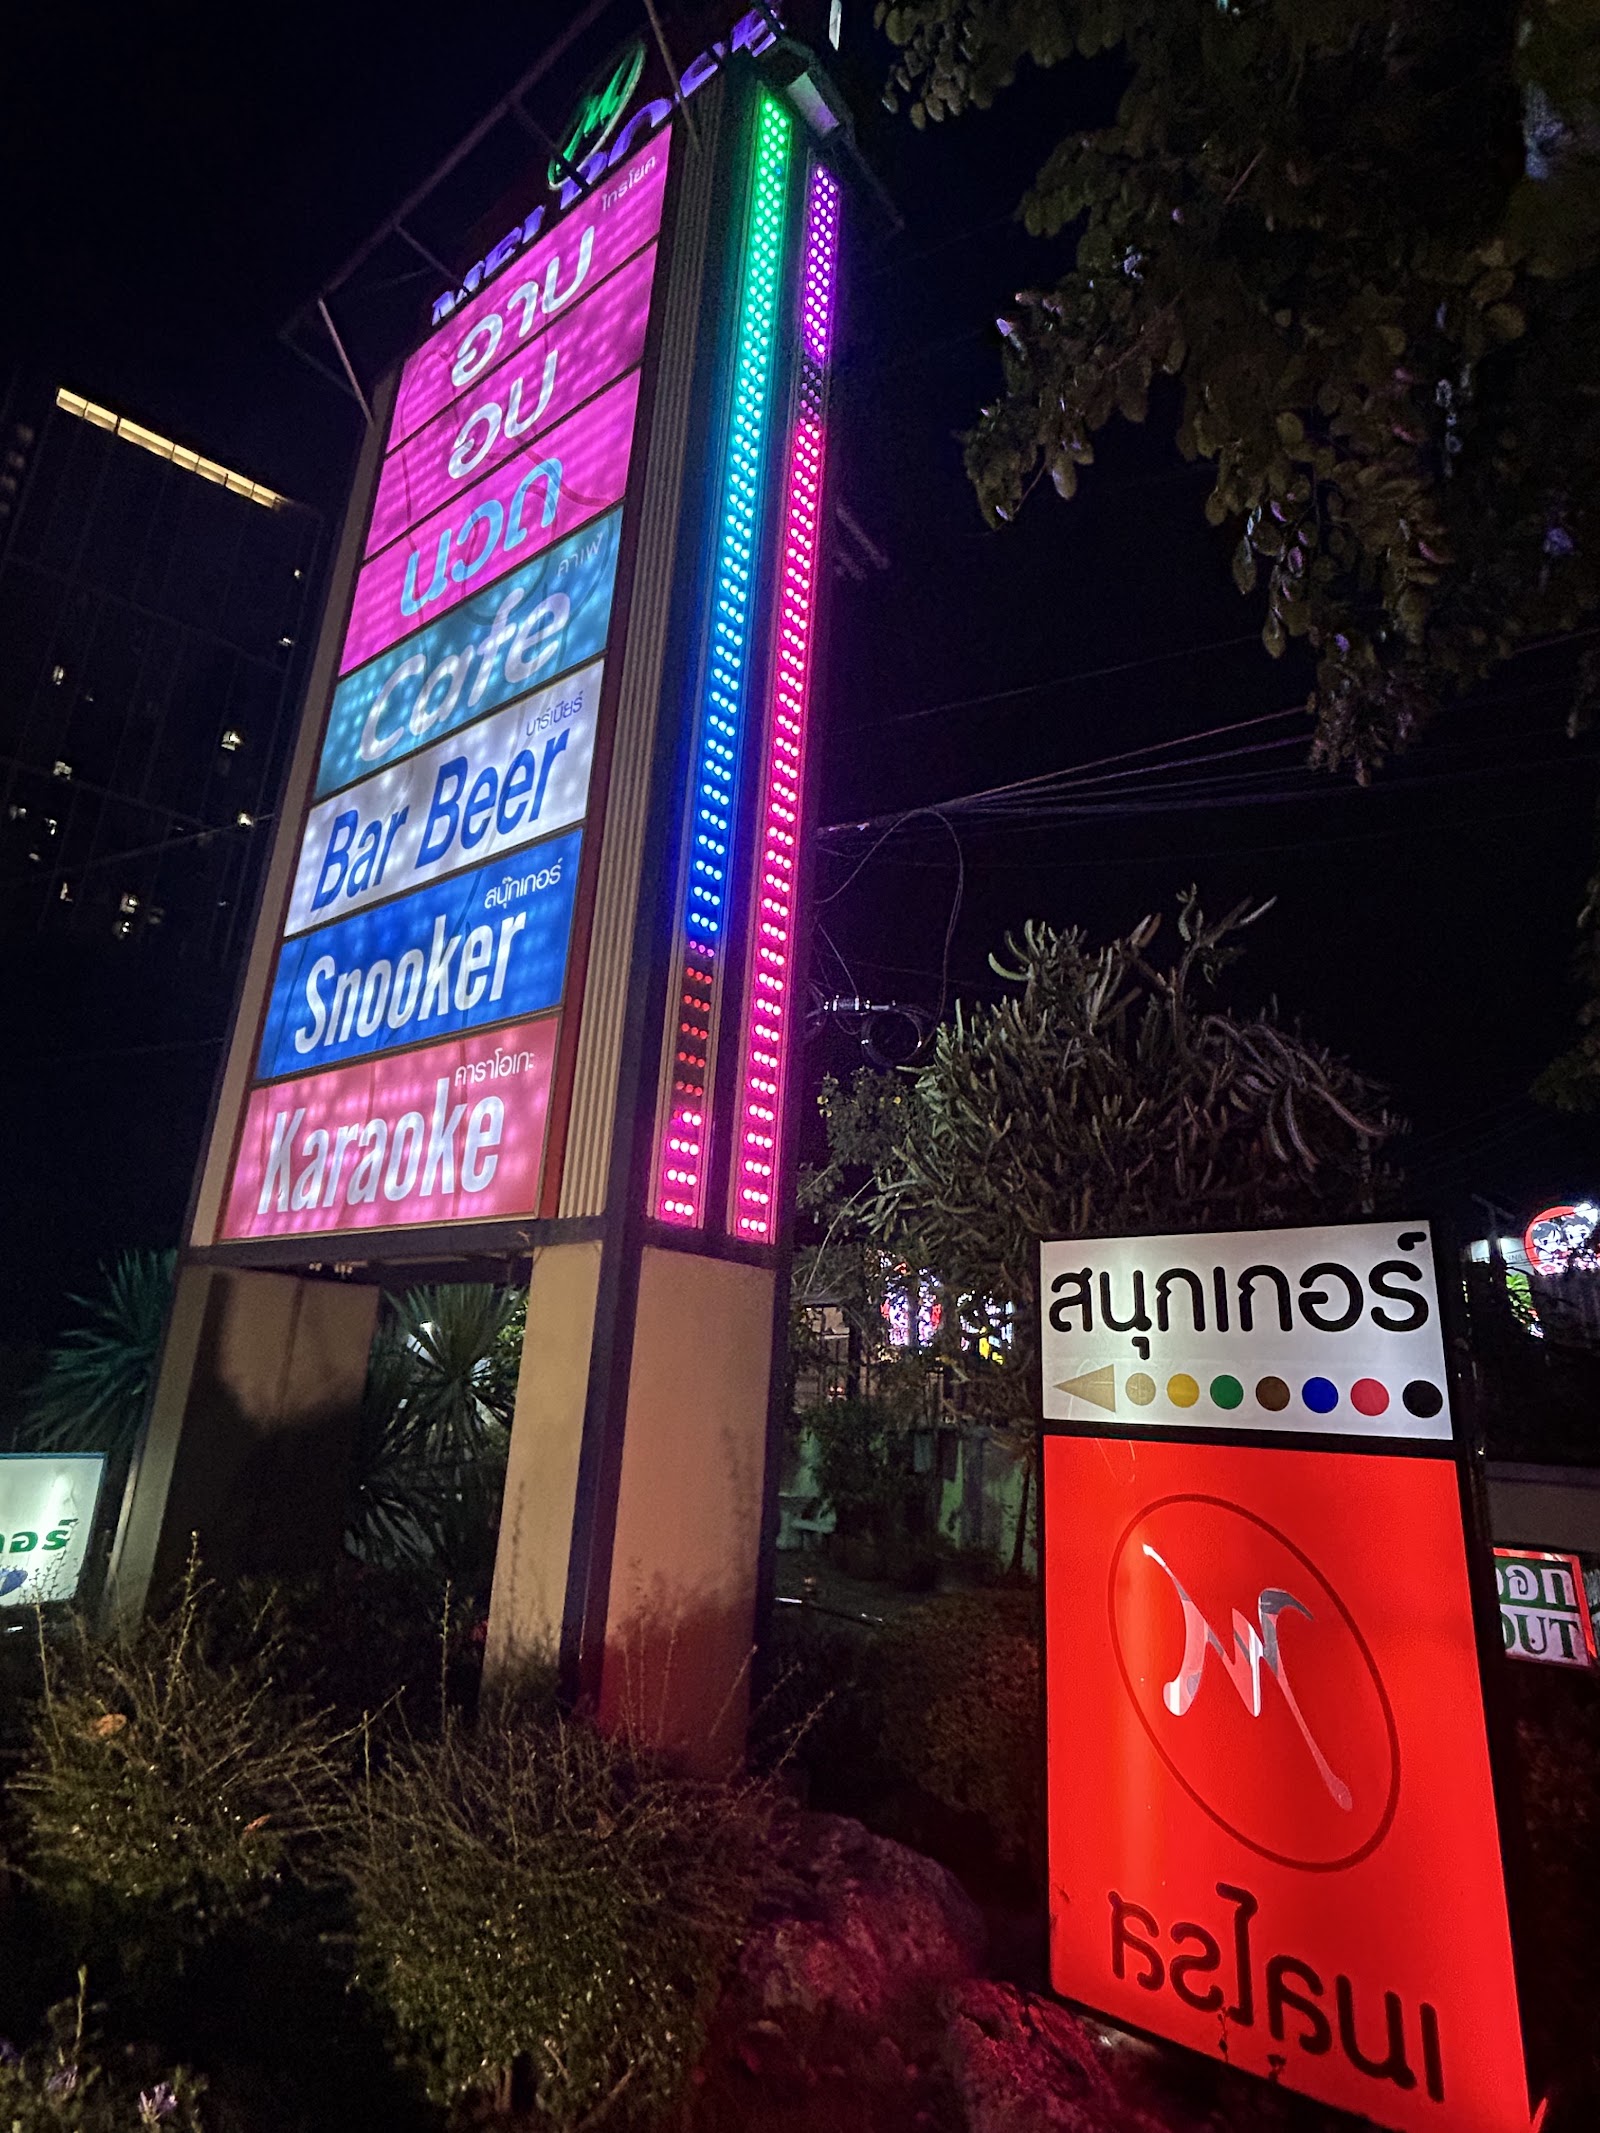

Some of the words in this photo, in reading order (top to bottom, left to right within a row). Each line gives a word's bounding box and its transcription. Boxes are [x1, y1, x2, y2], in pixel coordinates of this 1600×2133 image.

[452, 226, 595, 387] อาบ
[448, 350, 559, 479] อบ
[401, 458, 563, 616] นวด
[359, 587, 571, 761] Cafe
[526, 690, 584, 737] บาร์เบียร์
[310, 804, 409, 911] Bar
[414, 727, 571, 871] Beer
[294, 911, 526, 1055] Snooker
[454, 1047, 535, 1087] คาราโอเกะ
[256, 1077, 503, 1216] Karaoke
[1048, 1231, 1430, 1360] สนุกเกอร์
[0, 1518, 79, 1554] อร์
[1495, 1564, 1577, 1606] อก
